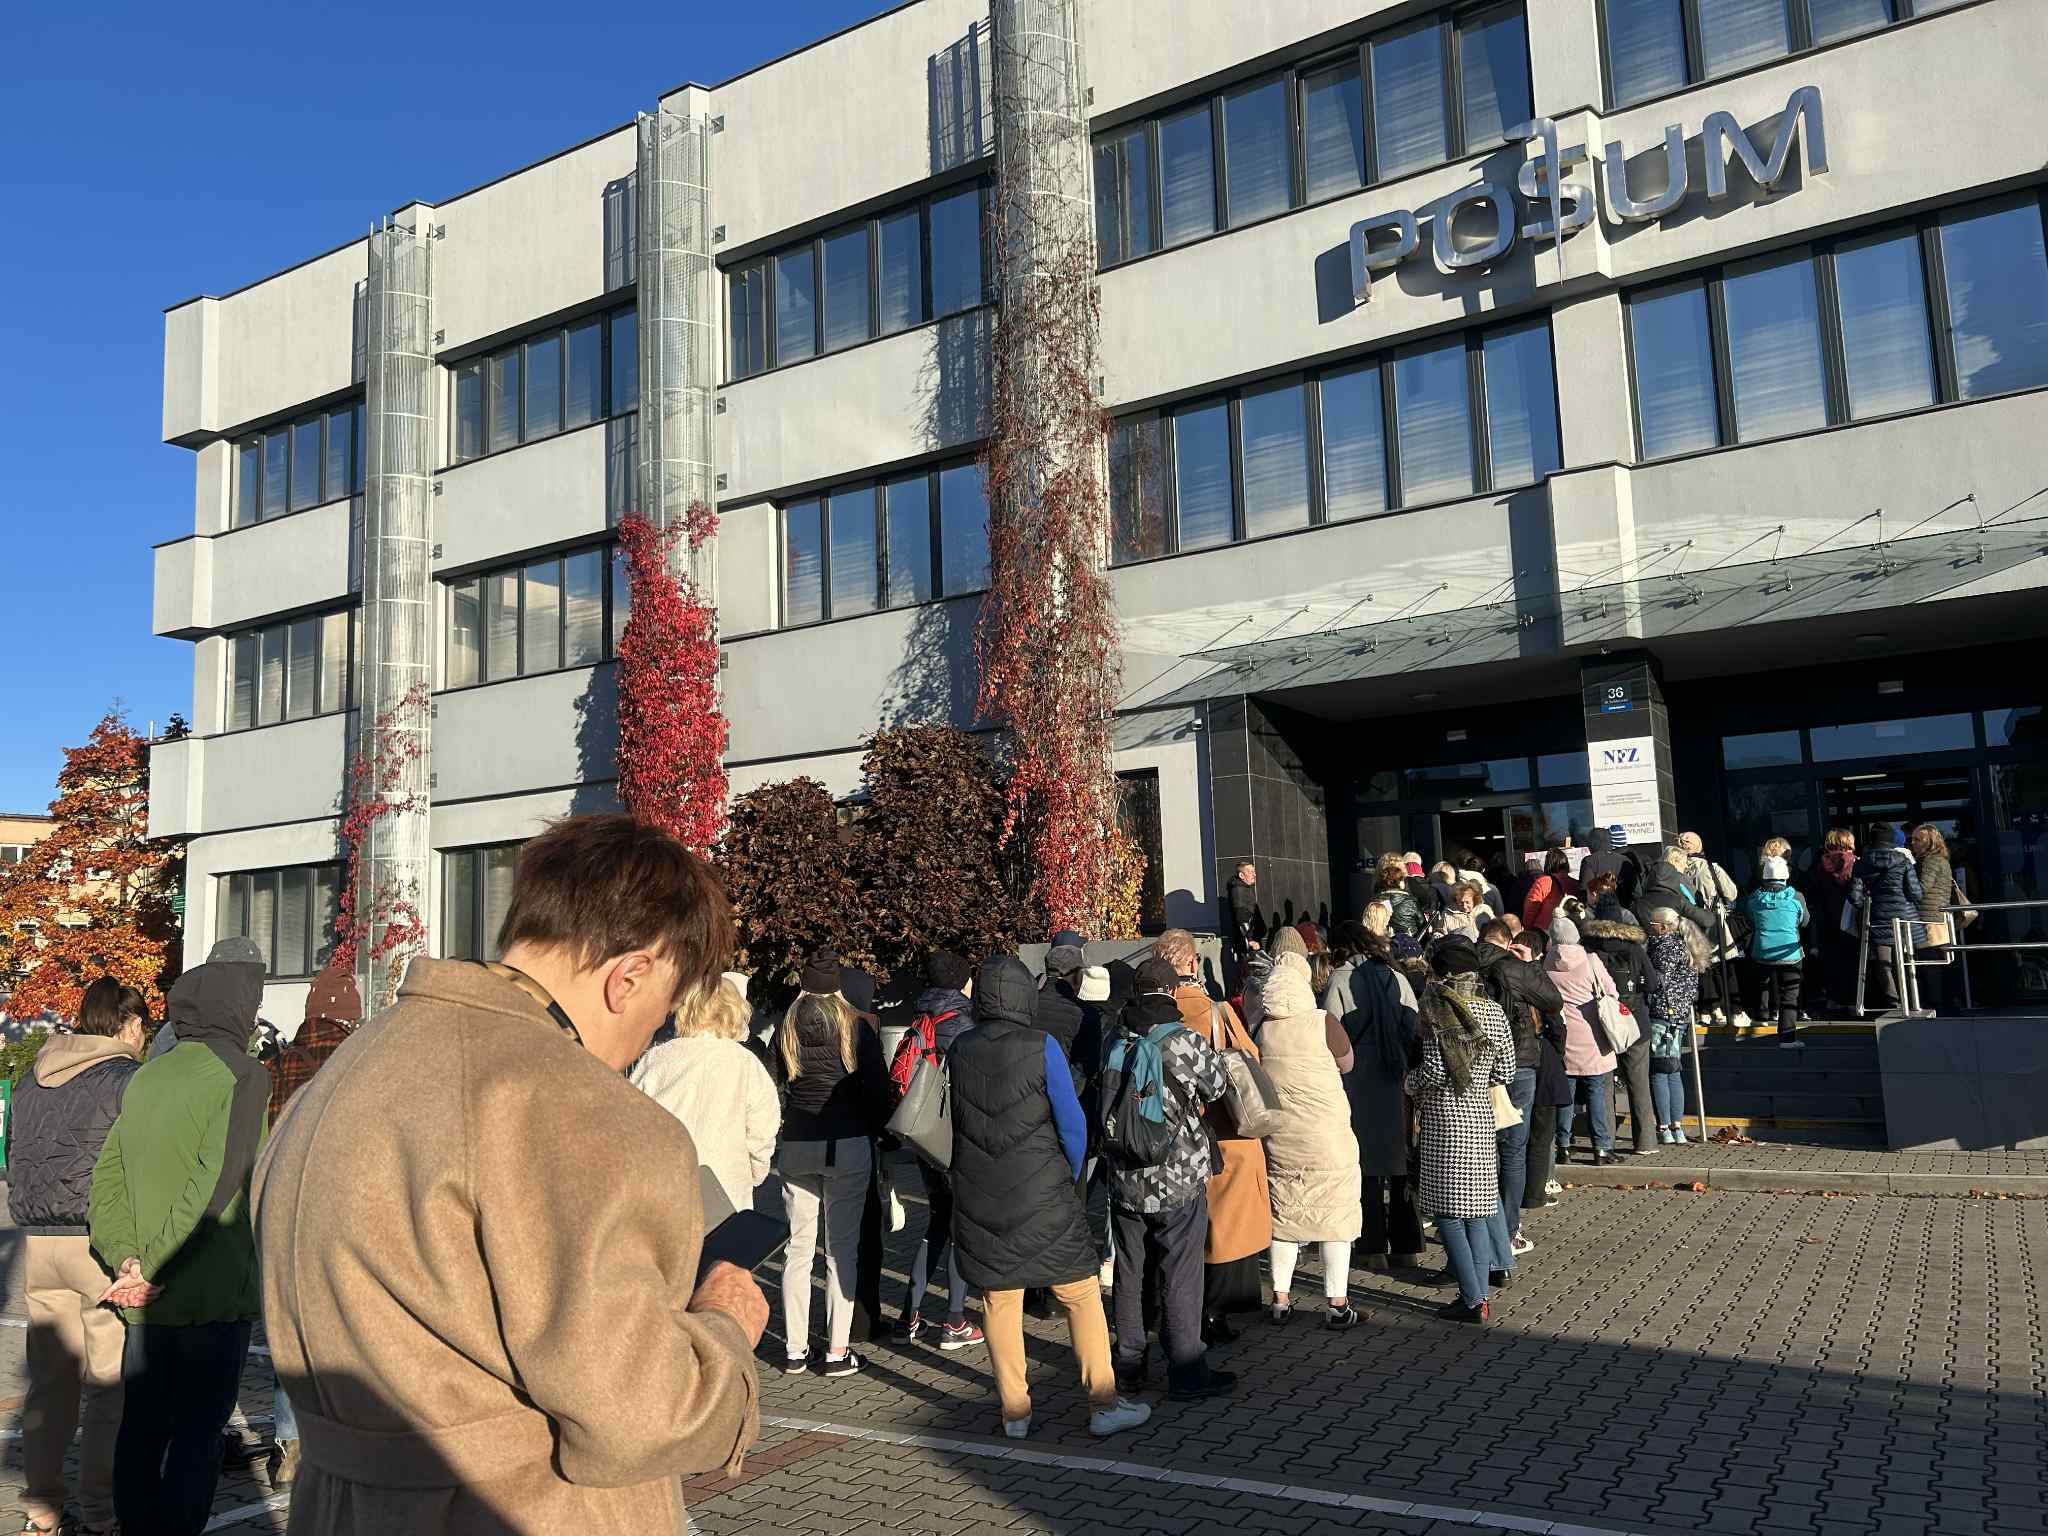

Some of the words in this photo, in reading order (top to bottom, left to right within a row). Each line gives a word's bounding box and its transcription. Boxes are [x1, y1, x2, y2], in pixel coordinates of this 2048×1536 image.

[1349, 85, 1830, 302] POSUM
[1607, 686, 1624, 698] 36
[1602, 748, 1640, 764] NFZ
